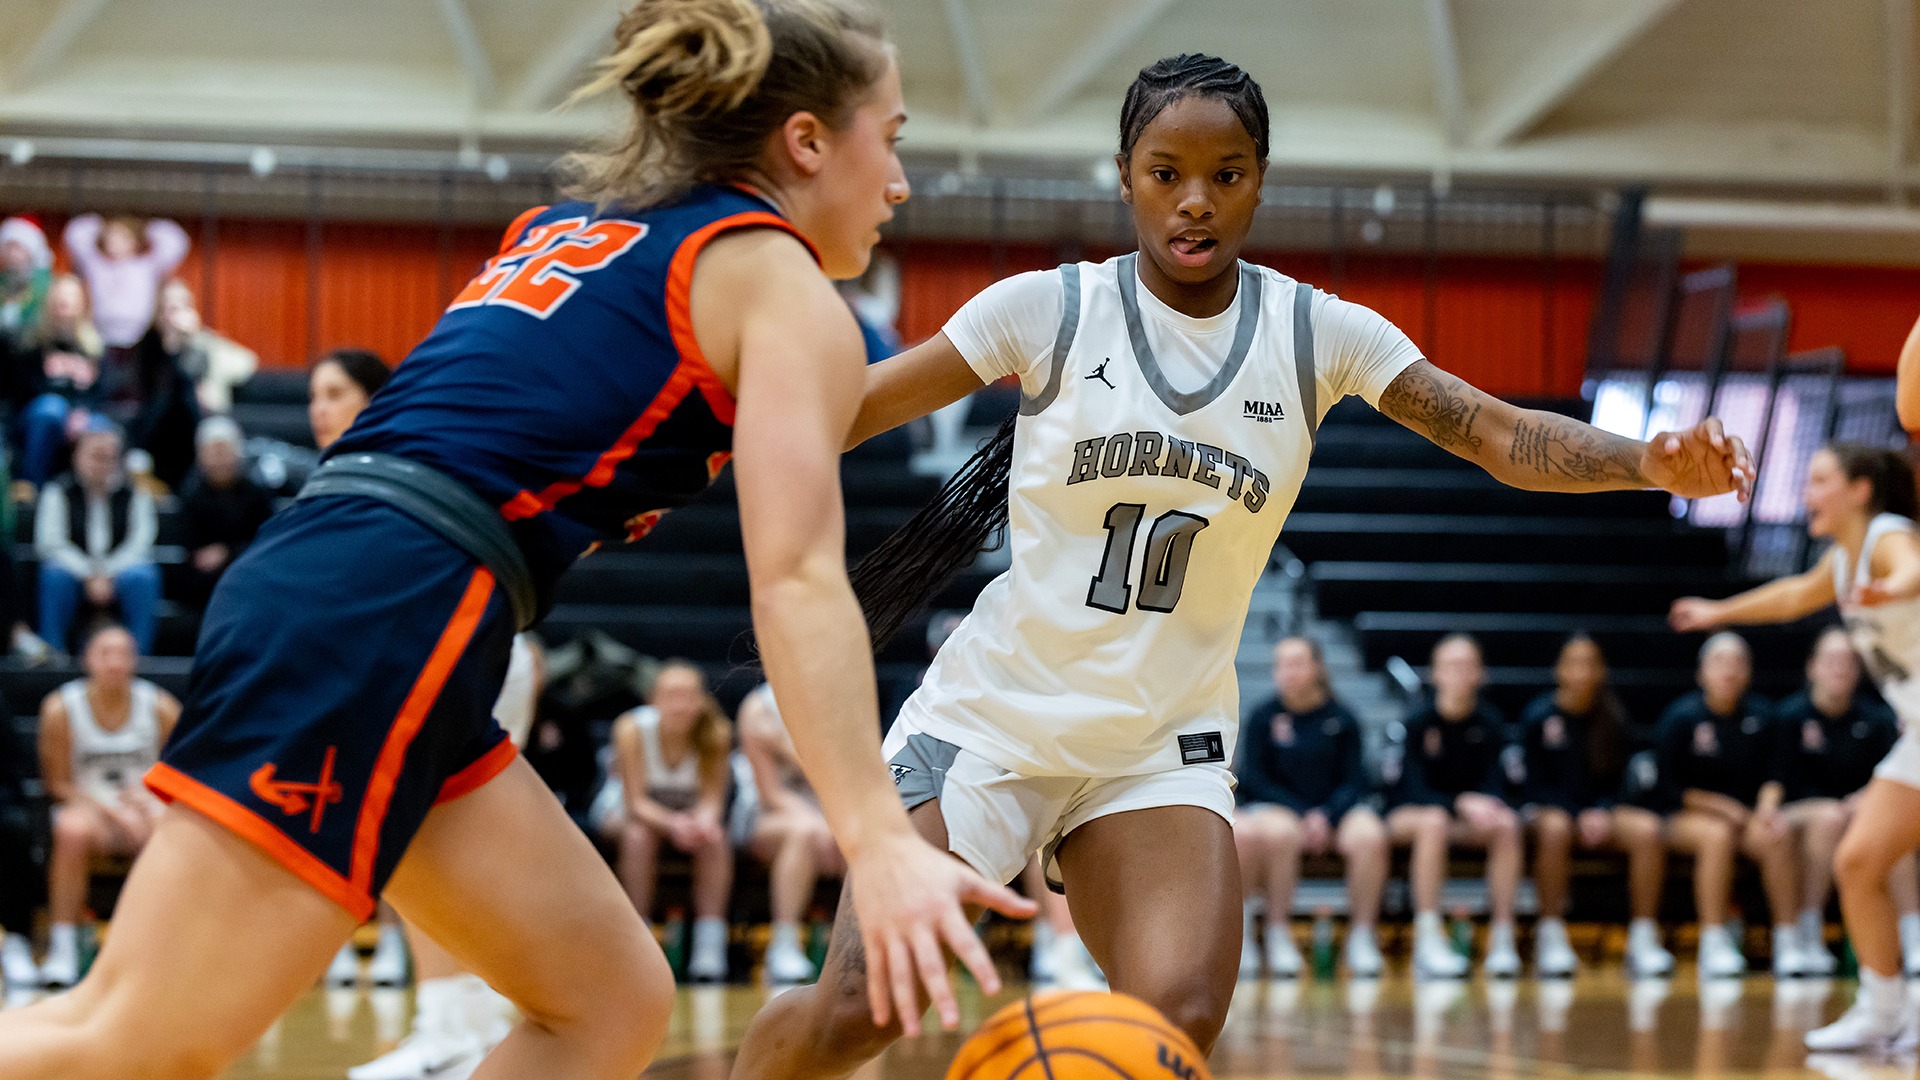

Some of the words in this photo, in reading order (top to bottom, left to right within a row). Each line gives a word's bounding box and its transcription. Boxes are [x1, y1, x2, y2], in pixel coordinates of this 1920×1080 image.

[445, 216, 649, 320] 22
[1243, 400, 1285, 416] MIAA
[1066, 431, 1270, 514] HORNETS
[1085, 502, 1210, 615] 10
